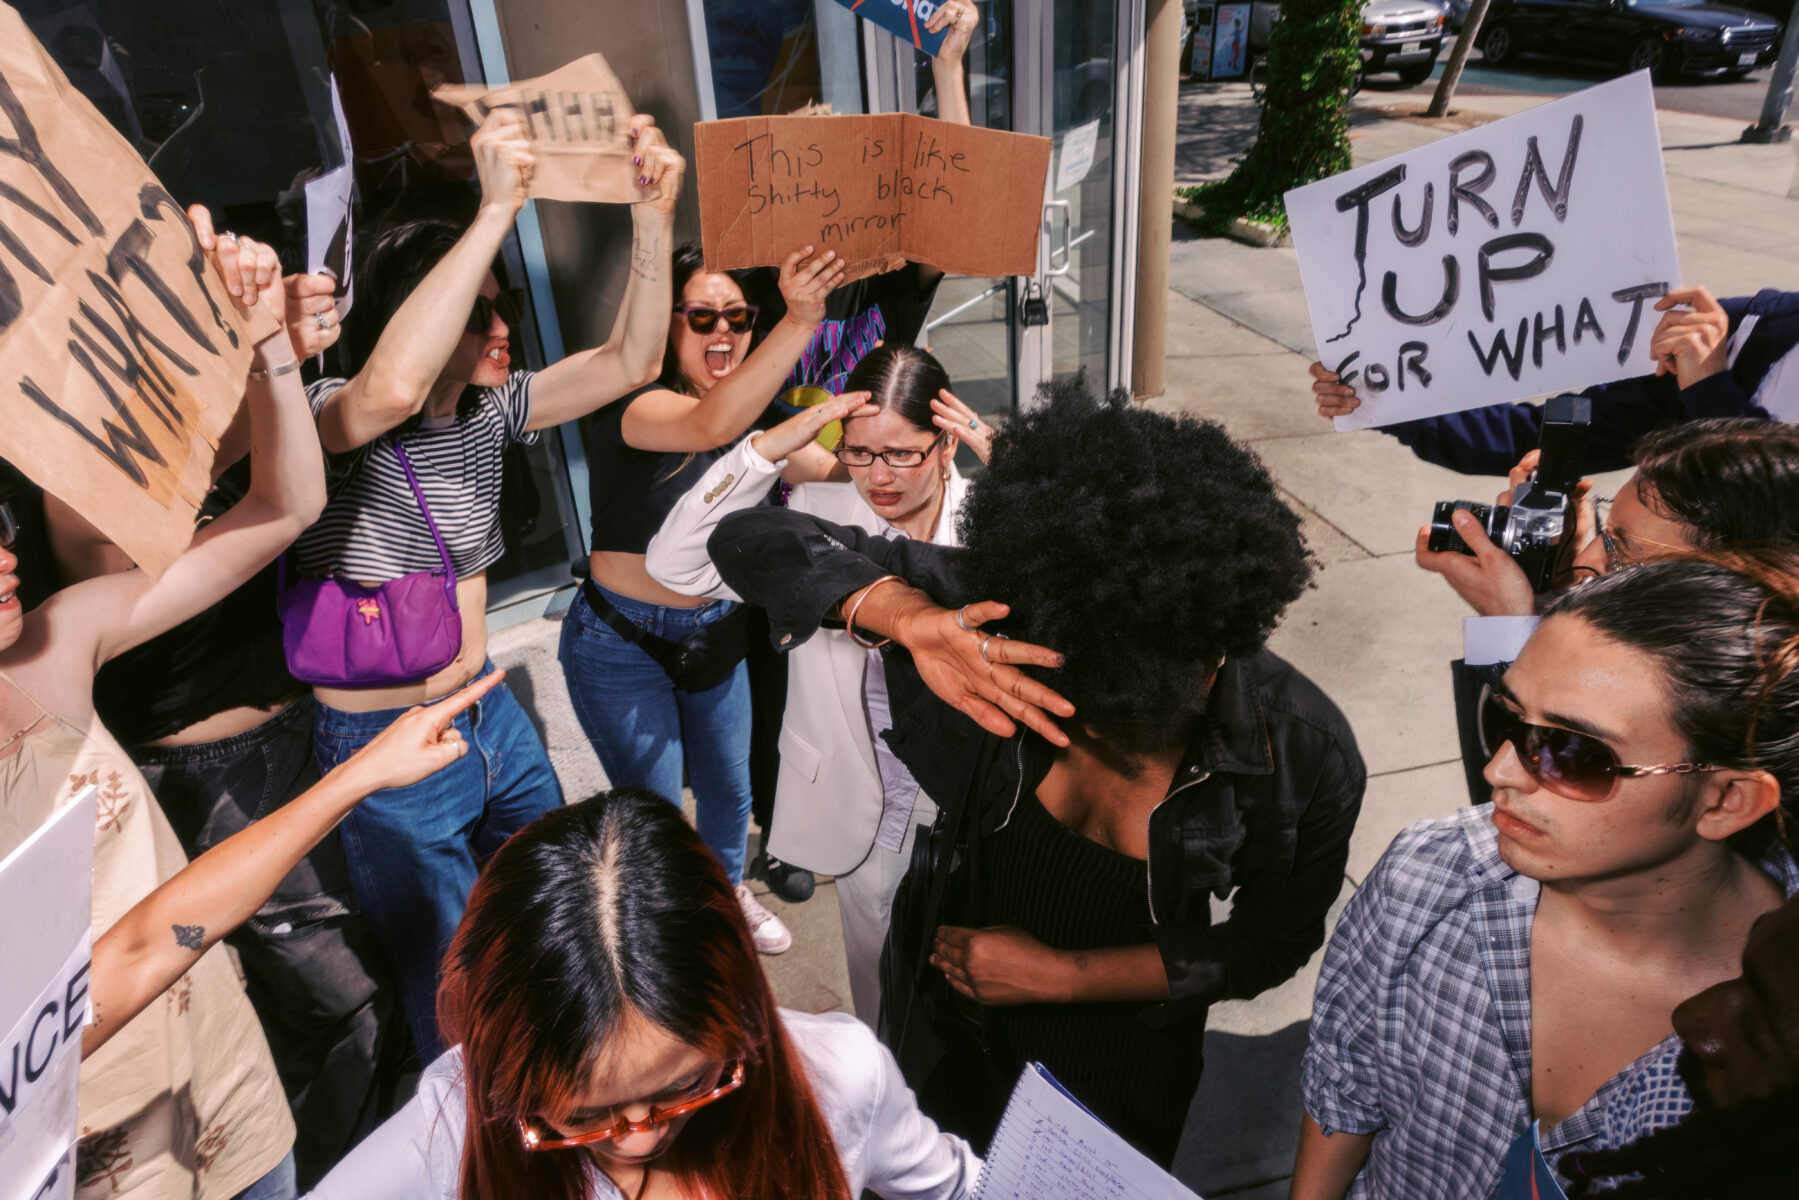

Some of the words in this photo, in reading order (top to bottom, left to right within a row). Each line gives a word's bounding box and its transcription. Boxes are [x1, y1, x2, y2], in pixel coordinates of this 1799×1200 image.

[734, 132, 824, 182] This
[861, 136, 884, 164] is
[913, 131, 970, 172] like
[878, 168, 953, 205] black
[820, 212, 907, 243] mirror
[1326, 113, 1585, 342] TURN
[1381, 232, 1556, 327] UP
[19, 181, 239, 490] WHAT?
[1336, 340, 1434, 393] FOR
[1466, 281, 1670, 382] WHAT
